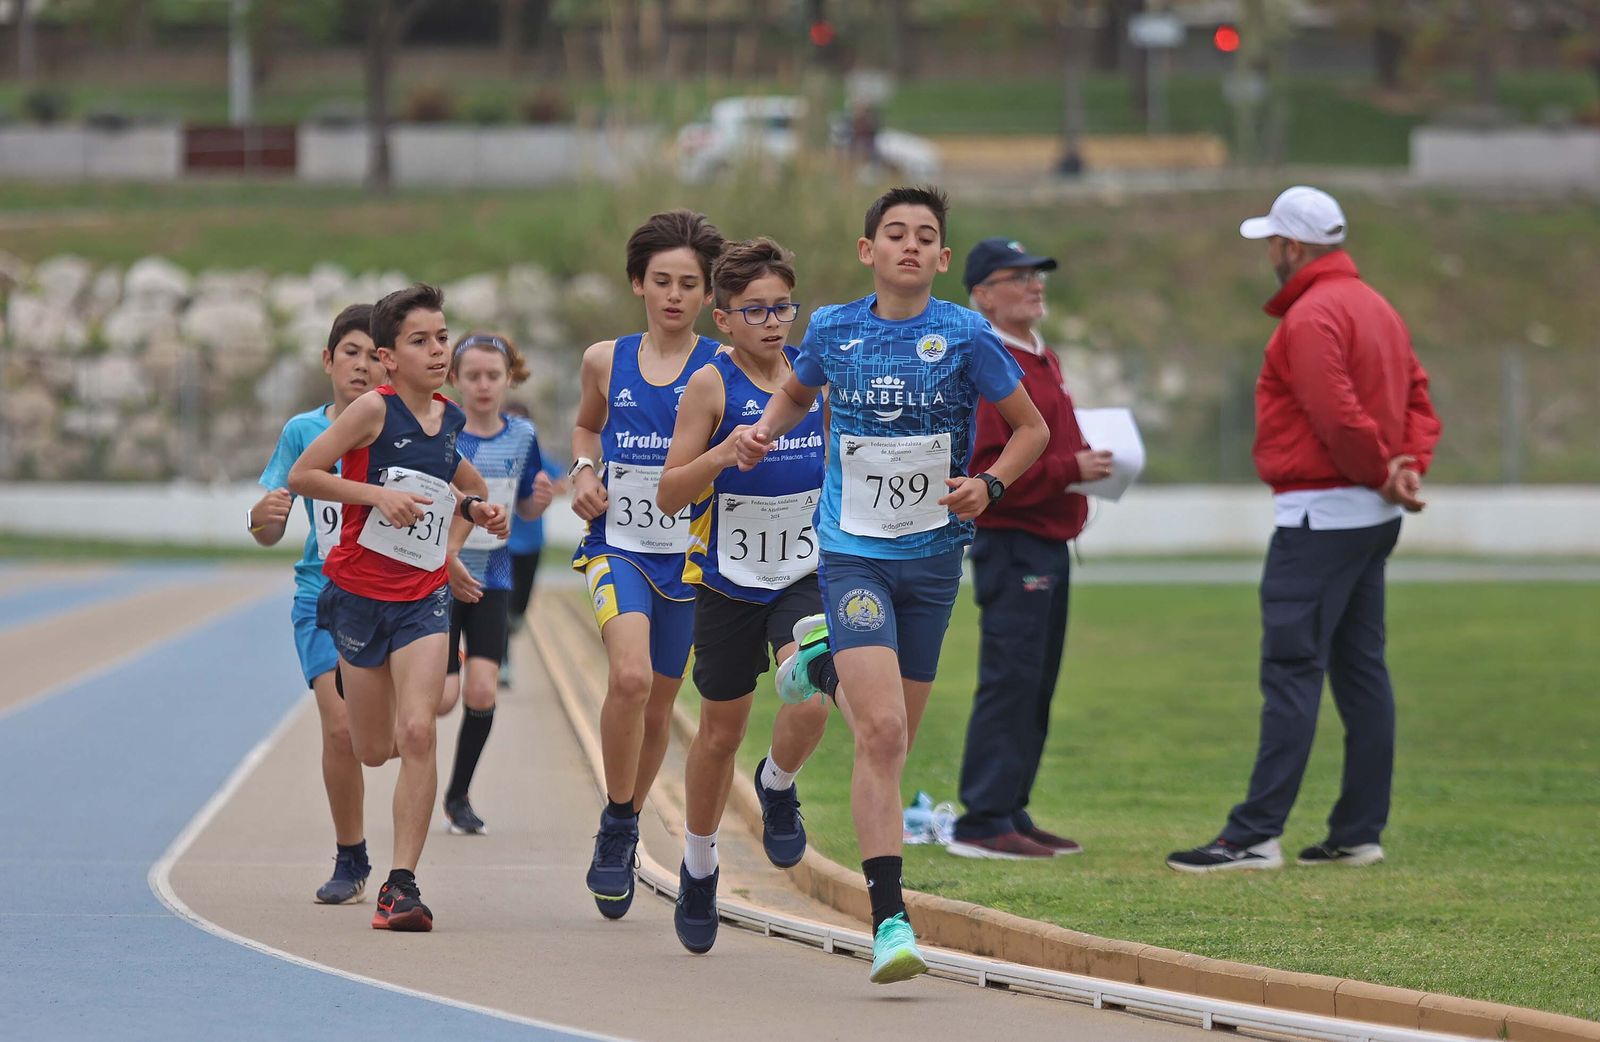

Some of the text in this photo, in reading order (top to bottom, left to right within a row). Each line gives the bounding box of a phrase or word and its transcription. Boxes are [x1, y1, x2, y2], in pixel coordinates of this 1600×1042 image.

[838, 390, 944, 406] MARBELLA
[865, 472, 929, 510] 789
[730, 526, 814, 563] 3115
